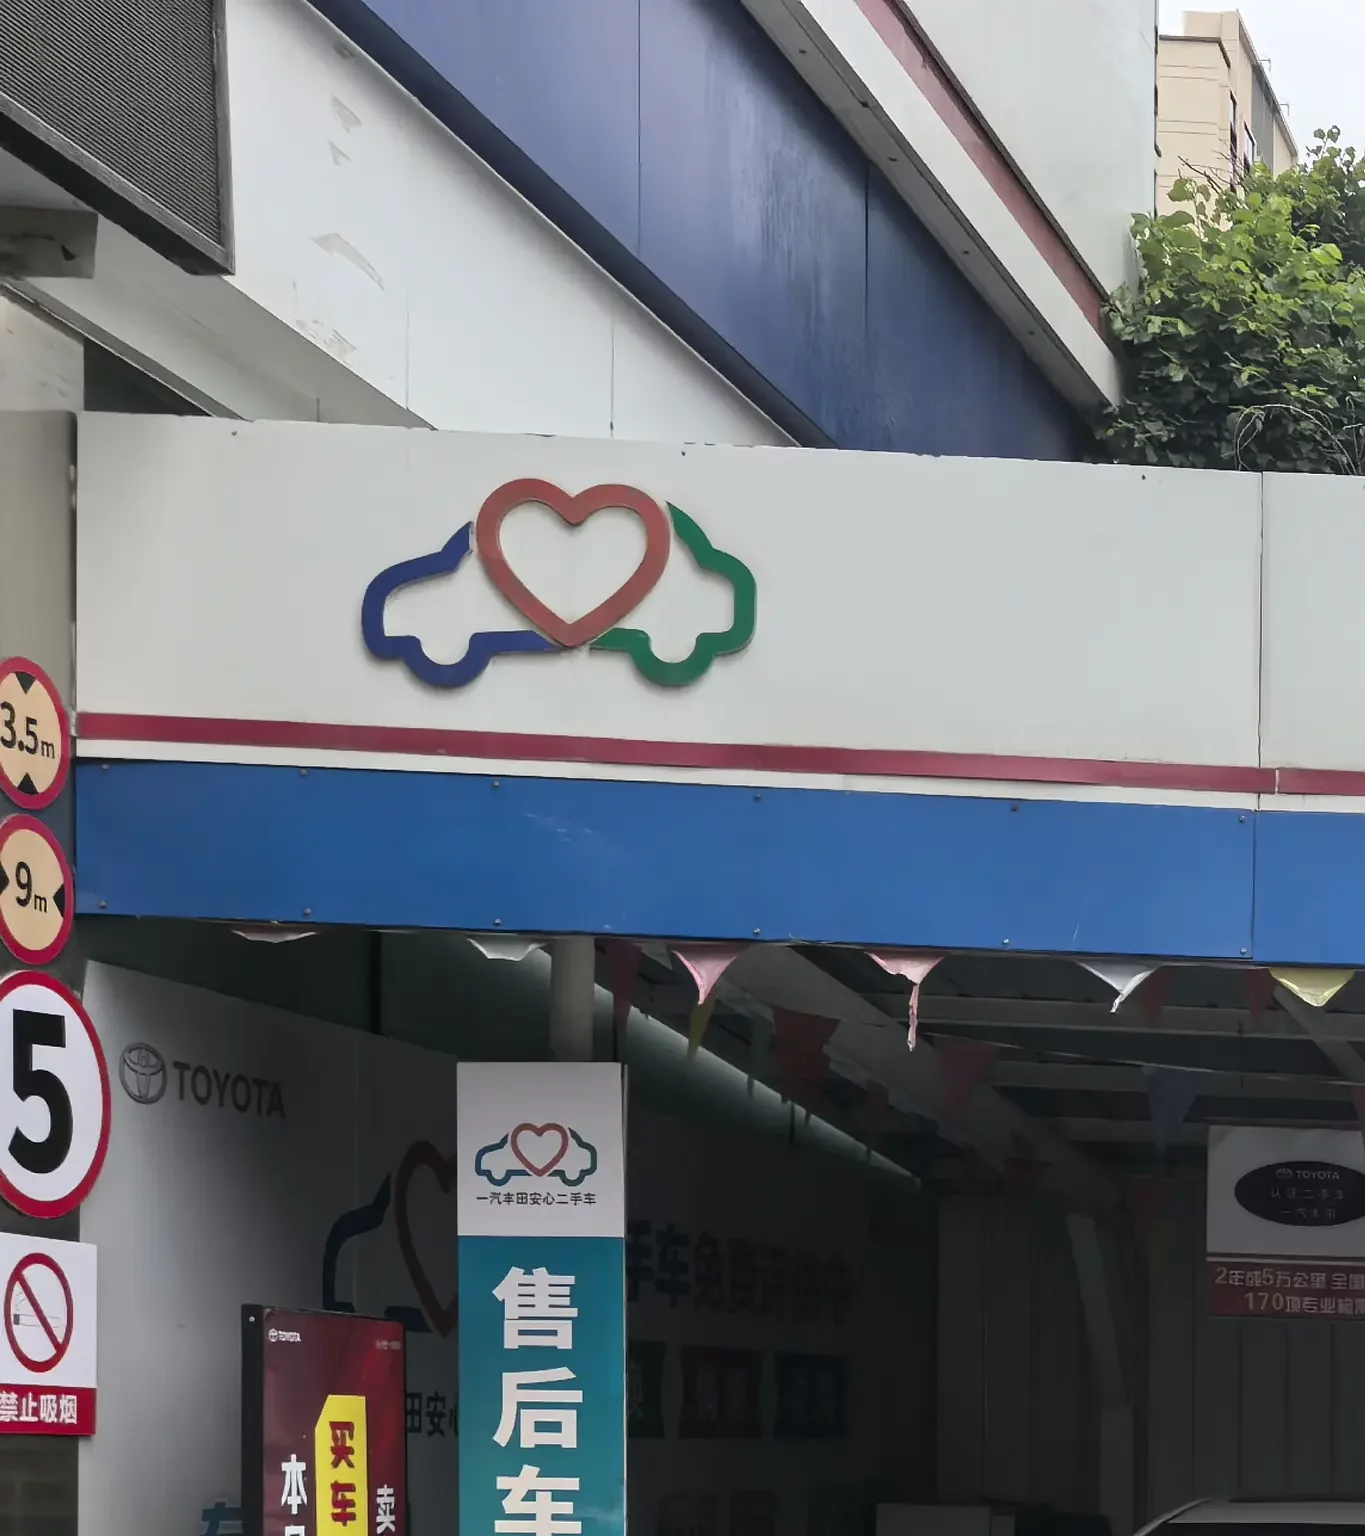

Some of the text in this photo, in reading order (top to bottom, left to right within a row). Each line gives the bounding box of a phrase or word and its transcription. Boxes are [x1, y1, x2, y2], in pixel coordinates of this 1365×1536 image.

[0, 701, 56, 760] 3.5m
[15, 861, 48, 914] 9m
[8, 1008, 74, 1174] 5
[173, 1061, 286, 1119] TOYOTA
[475, 1191, 597, 1206] 一汽丰田安心二手车
[1295, 1171, 1341, 1181] TOYOTA
[0, 1389, 78, 1425] 禁止吸烟
